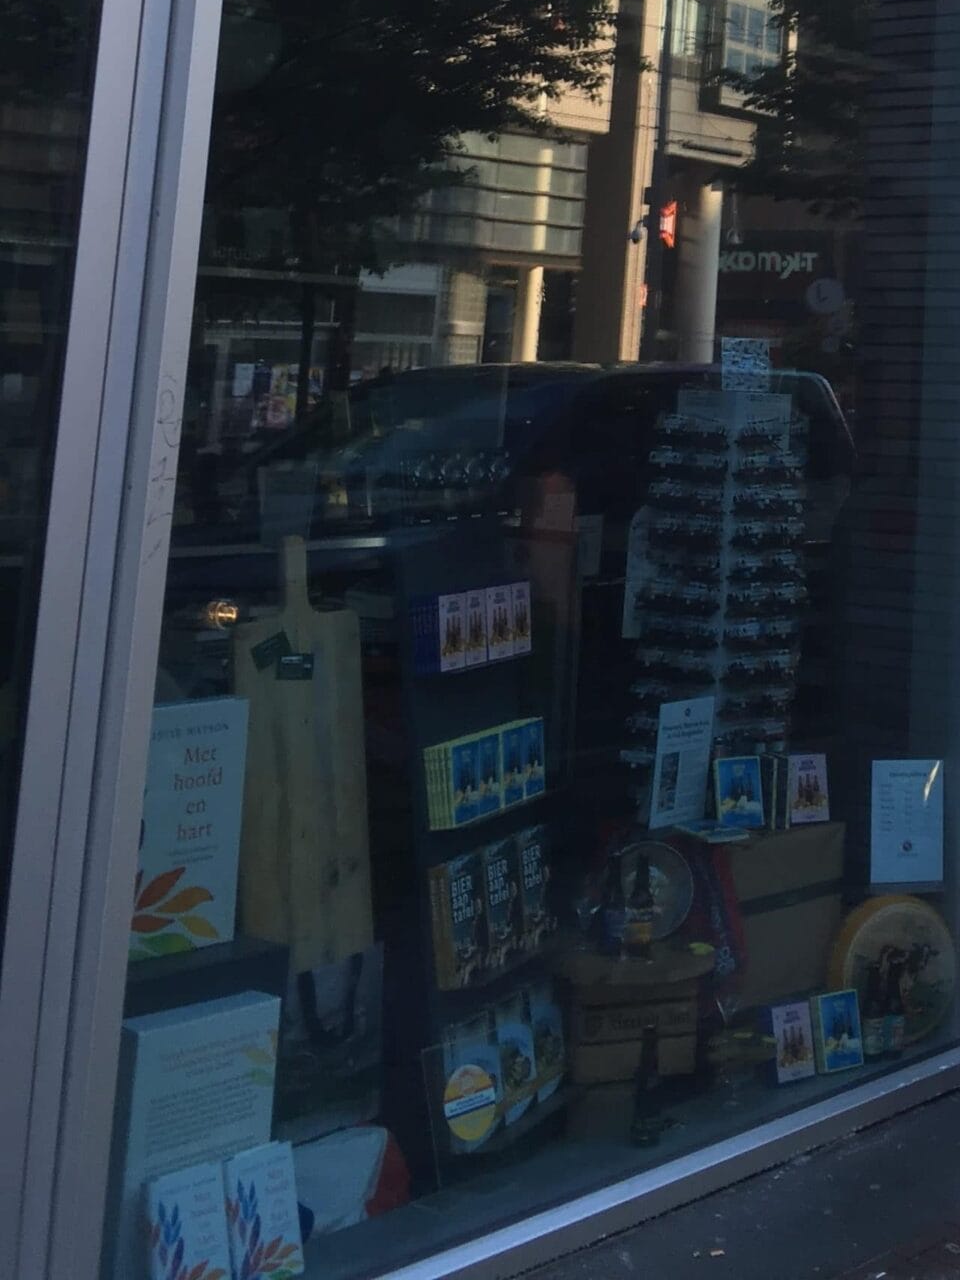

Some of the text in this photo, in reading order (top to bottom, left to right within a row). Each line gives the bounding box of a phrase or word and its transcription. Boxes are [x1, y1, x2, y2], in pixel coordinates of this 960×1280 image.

[184, 746, 218, 765] Met
[173, 767, 223, 791] hoofd
[185, 799, 207, 815] en
[175, 822, 213, 840] hart
